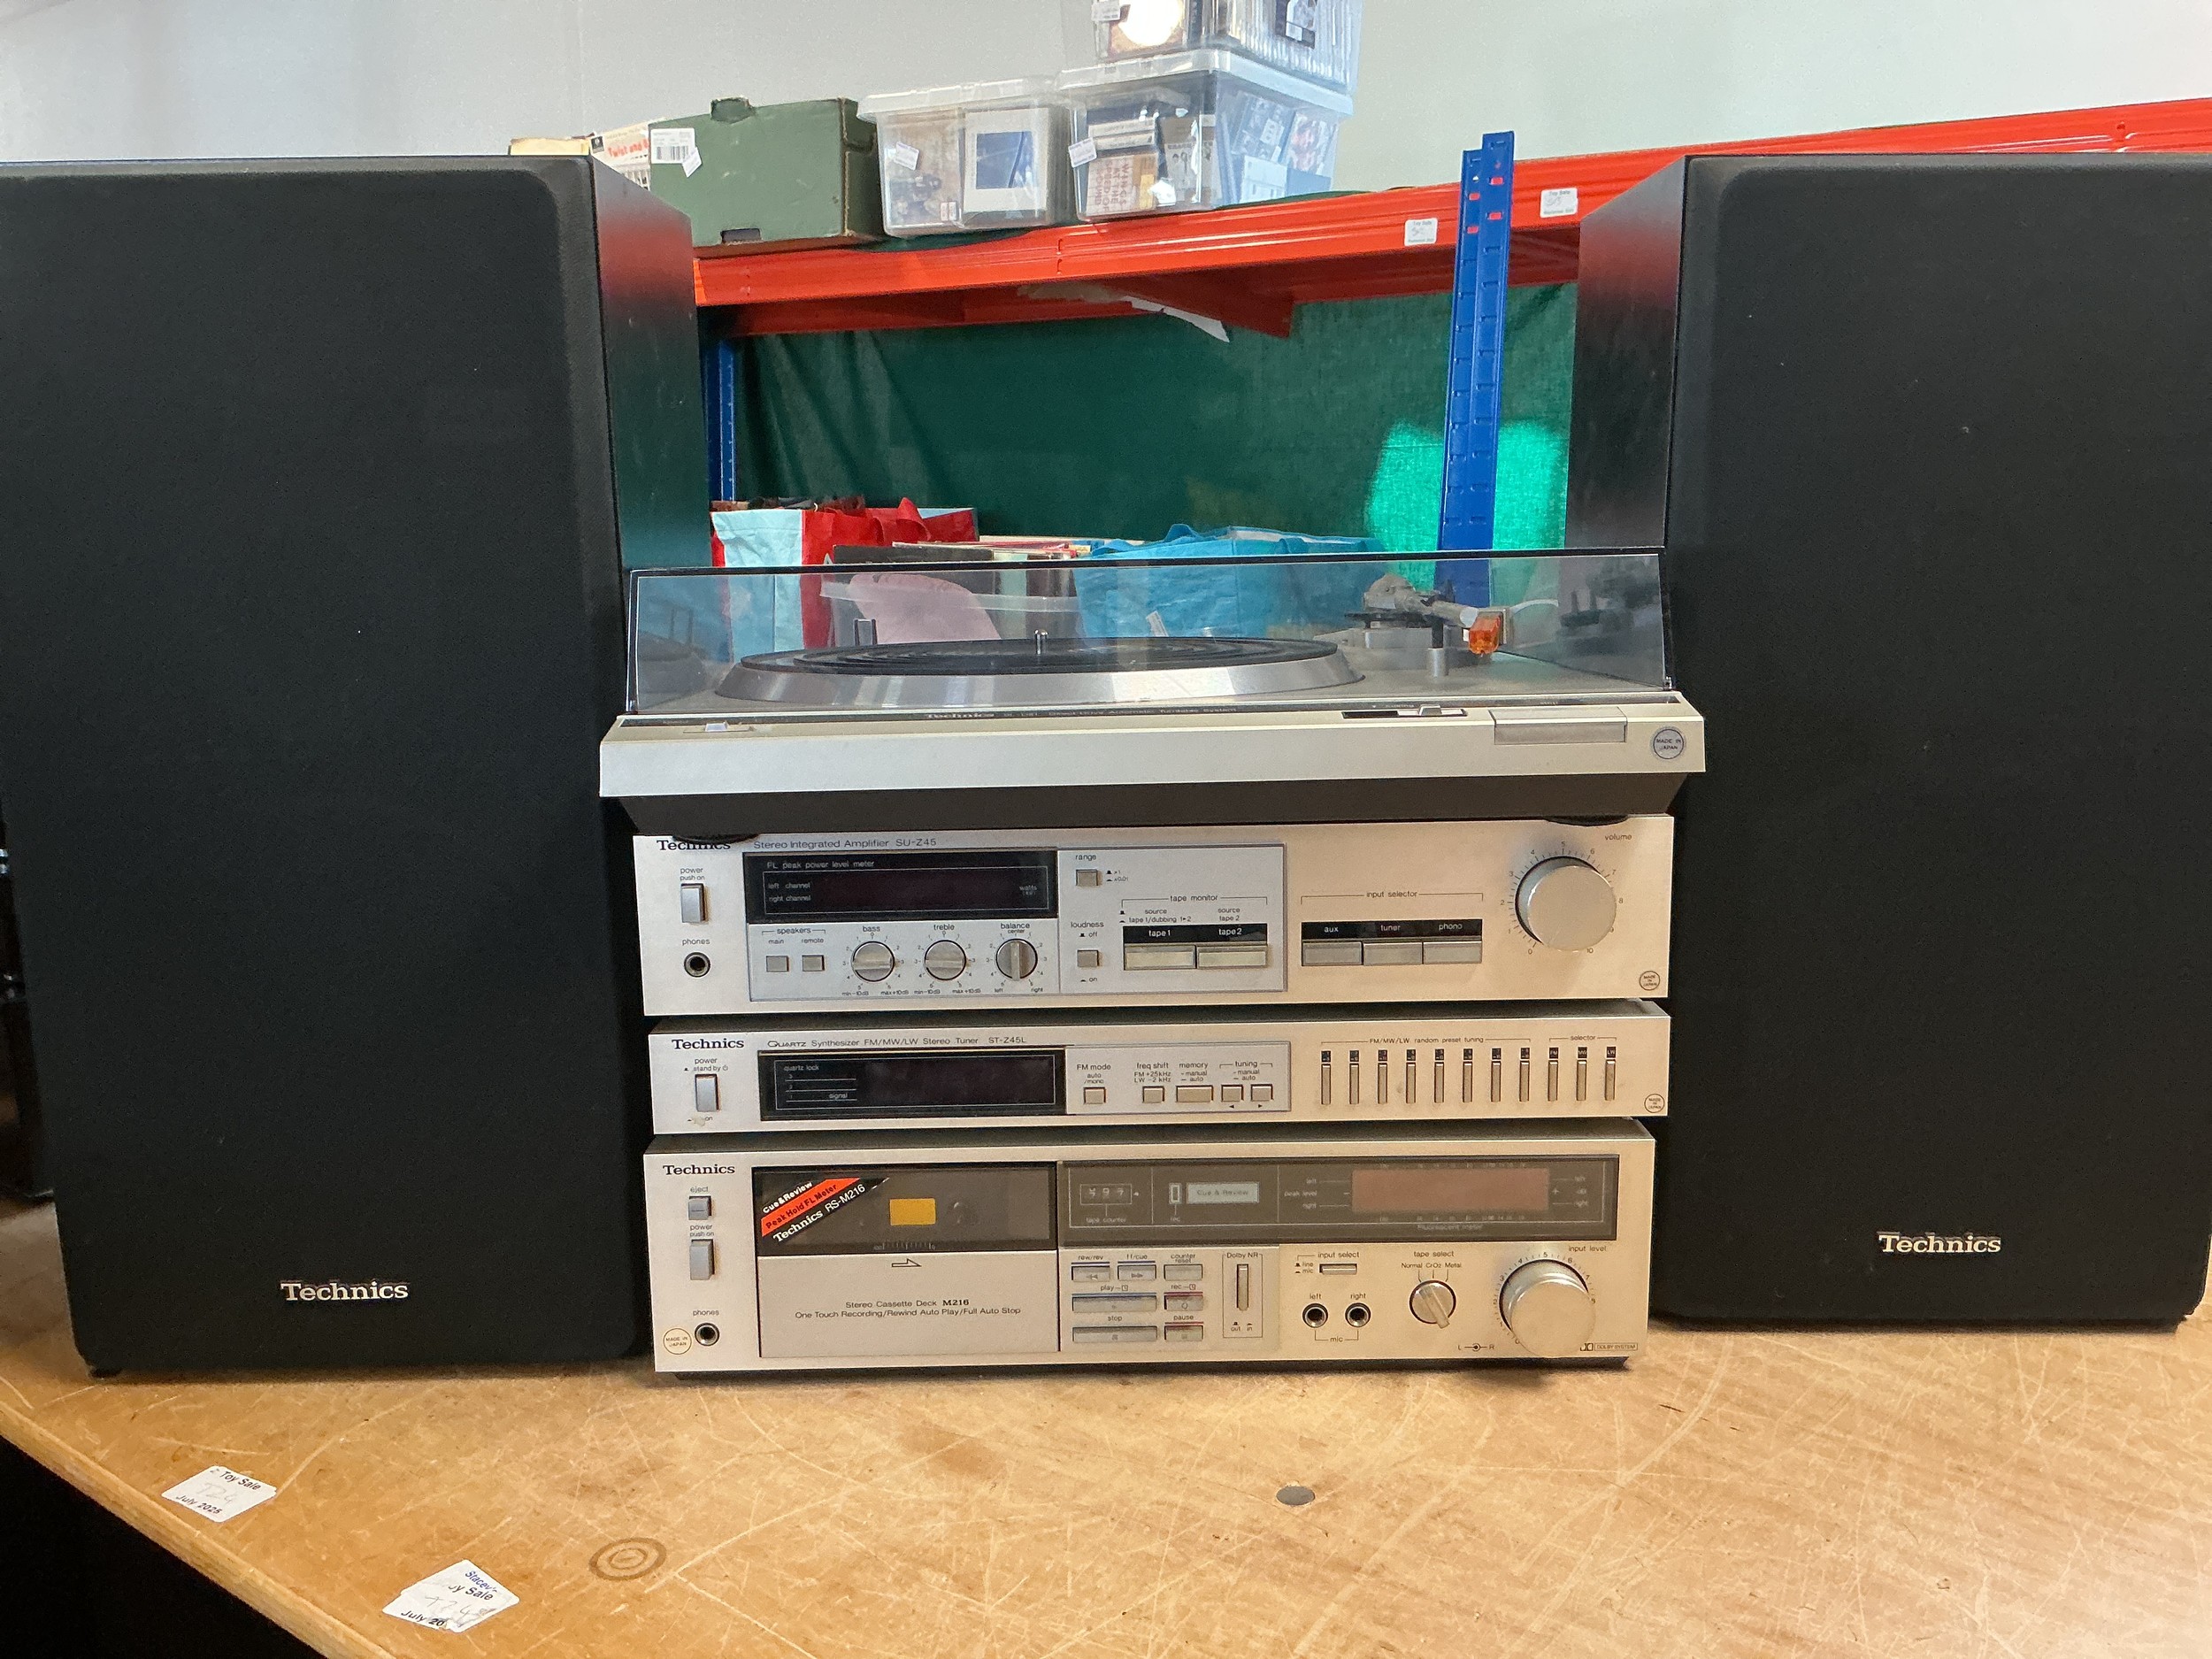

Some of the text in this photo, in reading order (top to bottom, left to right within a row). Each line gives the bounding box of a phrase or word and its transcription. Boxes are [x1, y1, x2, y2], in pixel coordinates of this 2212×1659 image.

[608, 145, 627, 157] Twist
[790, 840, 841, 850] Integrated
[844, 839, 889, 849] Amplifier
[895, 838, 937, 847] SU-Z45
[782, 861, 802, 871] peak
[1439, 923, 1463, 932] phono
[672, 1038, 745, 1049] Technics
[811, 1040, 859, 1048] Synthesizer
[1136, 1062, 1151, 1071] freq
[663, 1164, 735, 1175] Technics
[763, 1181, 813, 1213] Cue&Review
[765, 1184, 838, 1229] Peak Hold FL Meter
[773, 1184, 866, 1242] Technics RS-M216
[1878, 1234, 2001, 1253] Technics
[280, 1280, 409, 1302] Technics
[841, 1309, 918, 1318] Recording/Rewind
[941, 1307, 978, 1316] Play/Full
[1002, 1306, 1021, 1315] Stop
[219, 1471, 262, 1490] Toy Sale
[176, 1494, 223, 1514] July 2025
[465, 1586, 494, 1601] Sale
[401, 1609, 446, 1627] July 20
